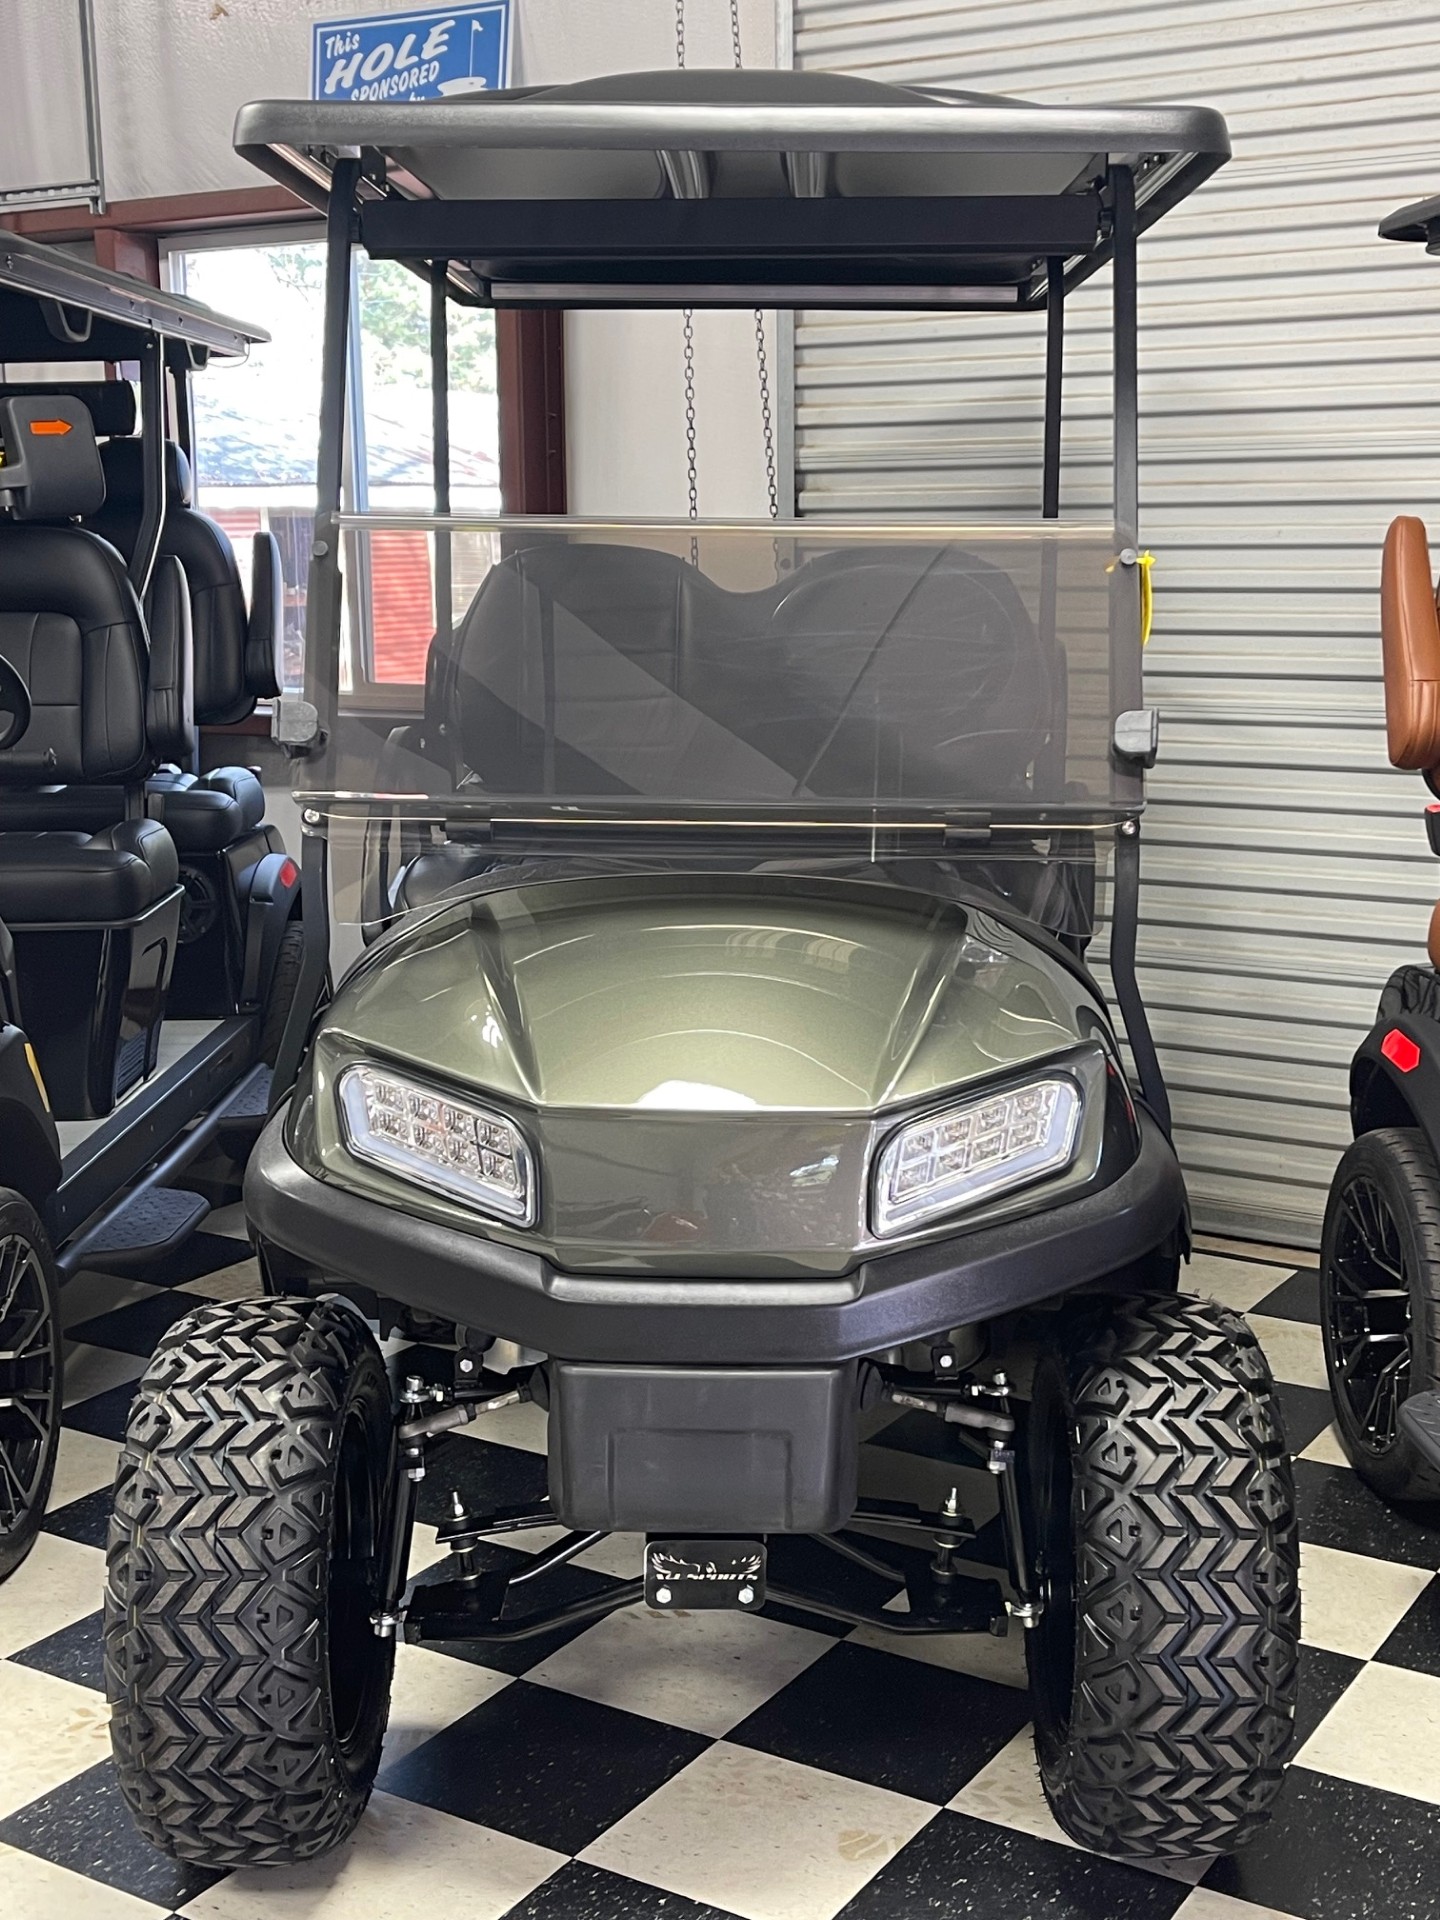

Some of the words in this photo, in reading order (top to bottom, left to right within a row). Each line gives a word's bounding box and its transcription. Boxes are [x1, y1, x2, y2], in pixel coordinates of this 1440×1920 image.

[324, 19, 456, 94] HOLE
[325, 32, 360, 59] This
[351, 61, 440, 101] SPONSORED
